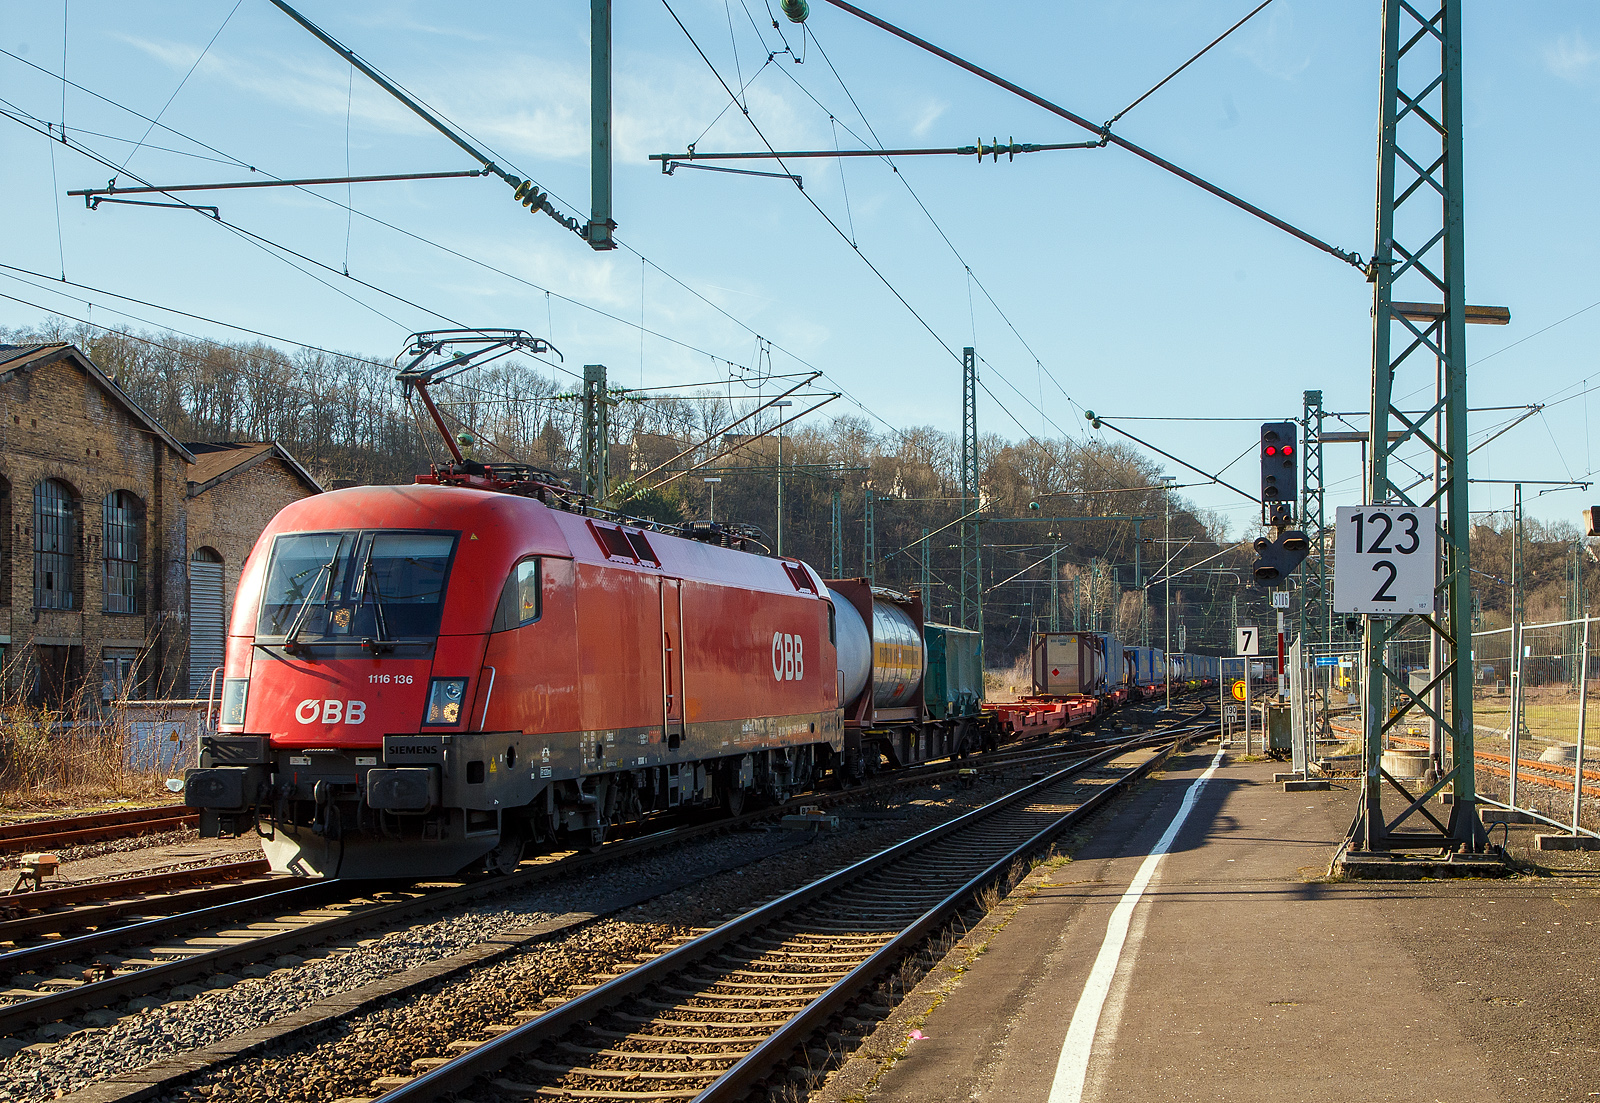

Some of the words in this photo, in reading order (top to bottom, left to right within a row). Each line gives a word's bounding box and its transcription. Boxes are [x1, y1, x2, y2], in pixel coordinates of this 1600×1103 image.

[1350, 512, 1420, 555] 123
[1371, 560, 1398, 602] 2
[1242, 630, 1253, 652] 7
[772, 631, 804, 682] ÖBB
[368, 674, 390, 684] 1116
[394, 674, 413, 685] 136
[295, 698, 367, 725] ÖBB
[1225, 706, 1237, 714] 190
[388, 745, 438, 755] SIEMENS
